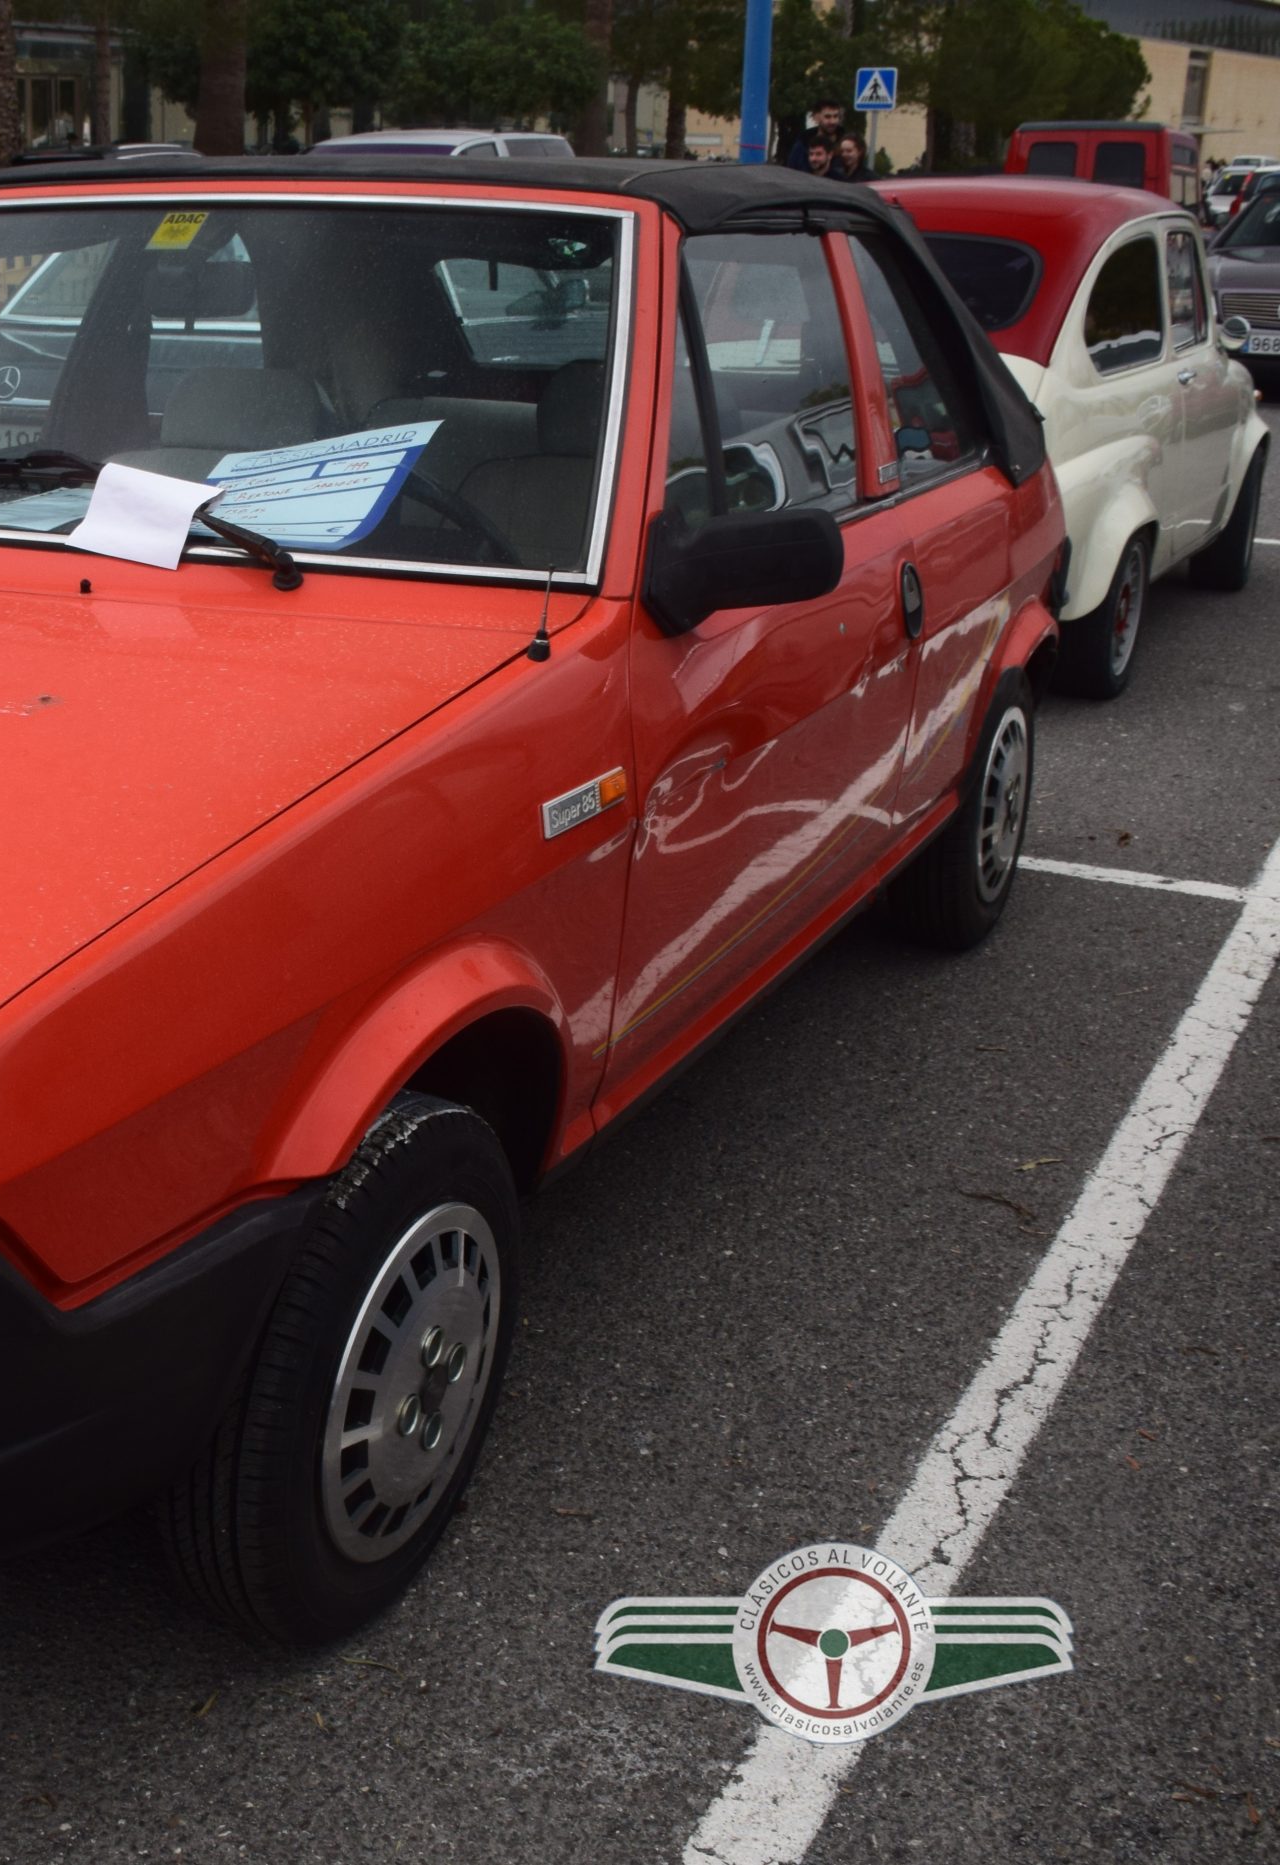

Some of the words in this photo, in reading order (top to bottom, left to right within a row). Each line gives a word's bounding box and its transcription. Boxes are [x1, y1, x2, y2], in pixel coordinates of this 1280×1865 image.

[164, 213, 206, 225] ADAC
[551, 805, 581, 829] Super
[581, 791, 595, 813] 85
